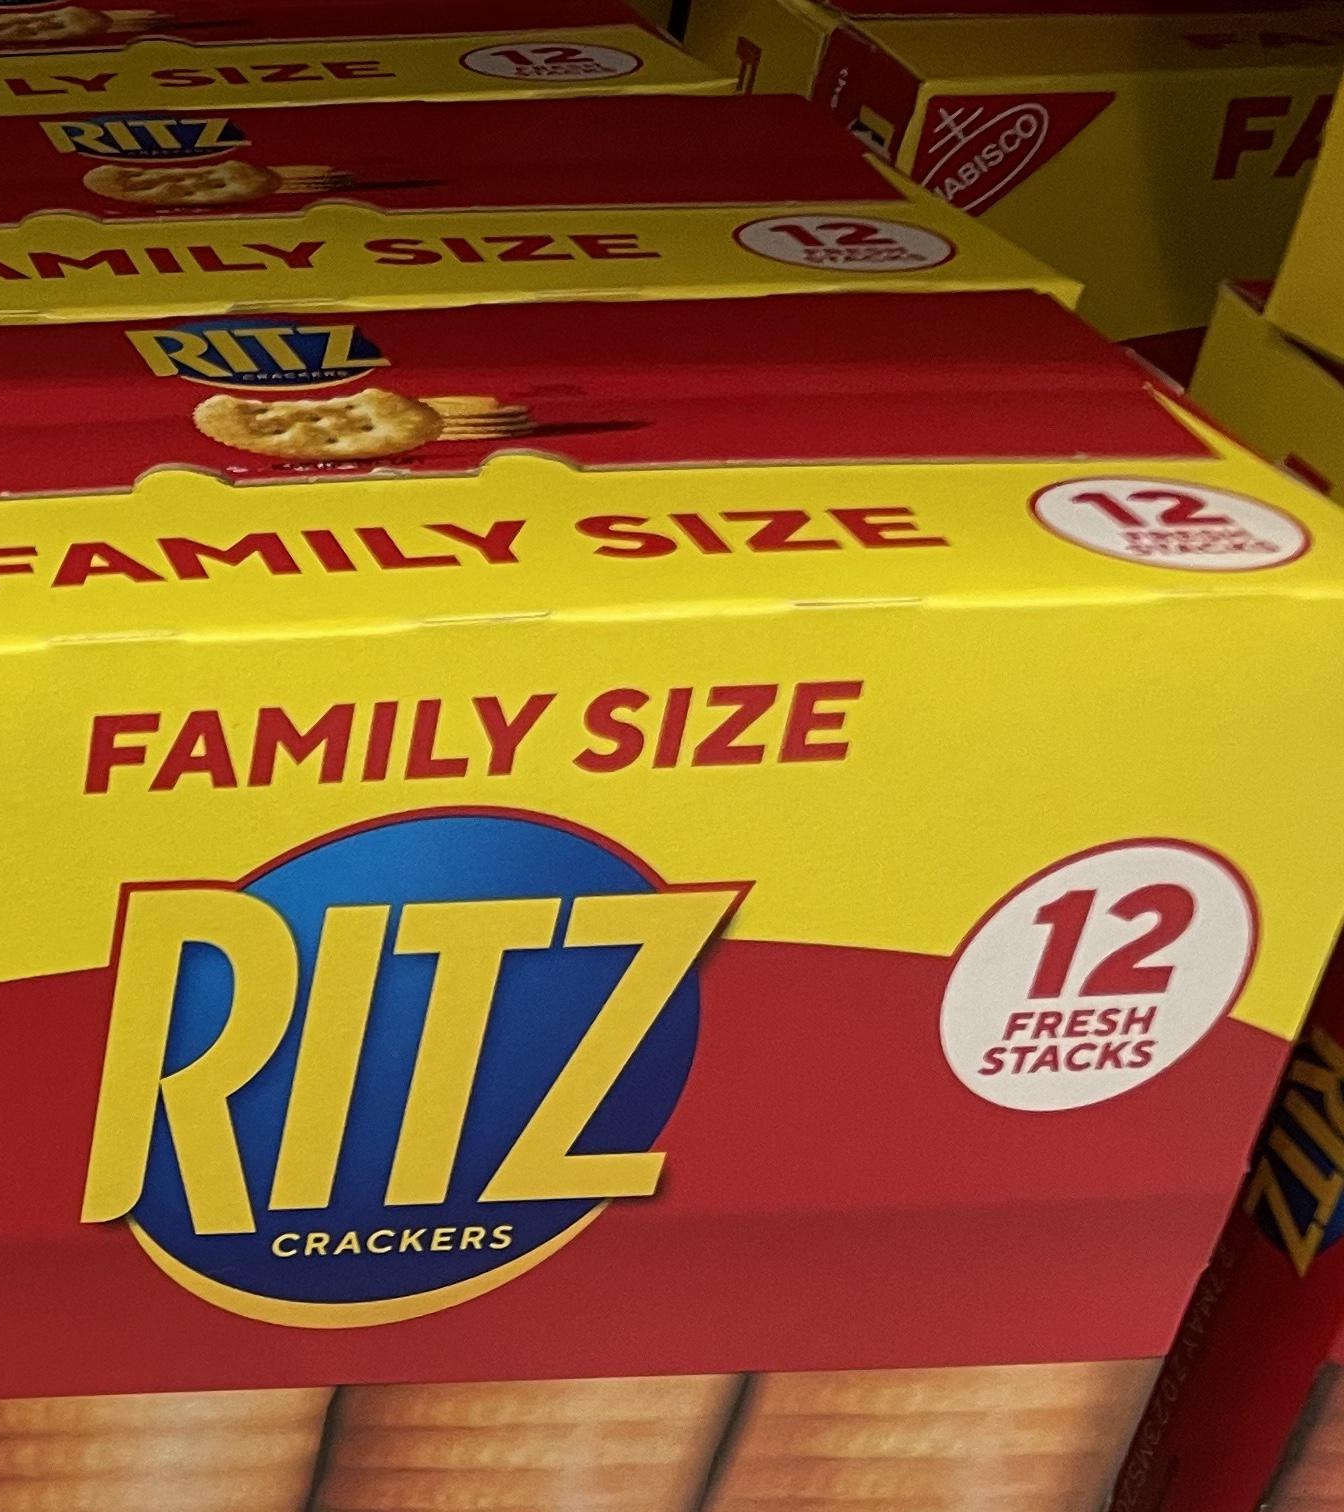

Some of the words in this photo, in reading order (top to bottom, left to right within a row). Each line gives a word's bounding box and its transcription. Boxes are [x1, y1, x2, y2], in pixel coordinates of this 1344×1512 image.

[491, 47, 593, 65] 12
[150, 61, 397, 88] SIZE
[39, 118, 252, 153] RITZ
[364, 233, 660, 266] SIZE
[769, 222, 898, 246] 12
[124, 325, 392, 377] RITZ
[1071, 490, 1232, 527] 12
[574, 505, 951, 560] SIZE
[82, 692, 558, 795] FAMILY
[571, 680, 865, 774] SIZE
[1029, 882, 1199, 1000] 12
[1001, 1005, 1158, 1041] FRESH
[80, 886, 734, 1236] RITZ
[977, 1040, 1158, 1079] STACKS
[270, 1222, 516, 1258] CRACKERS
